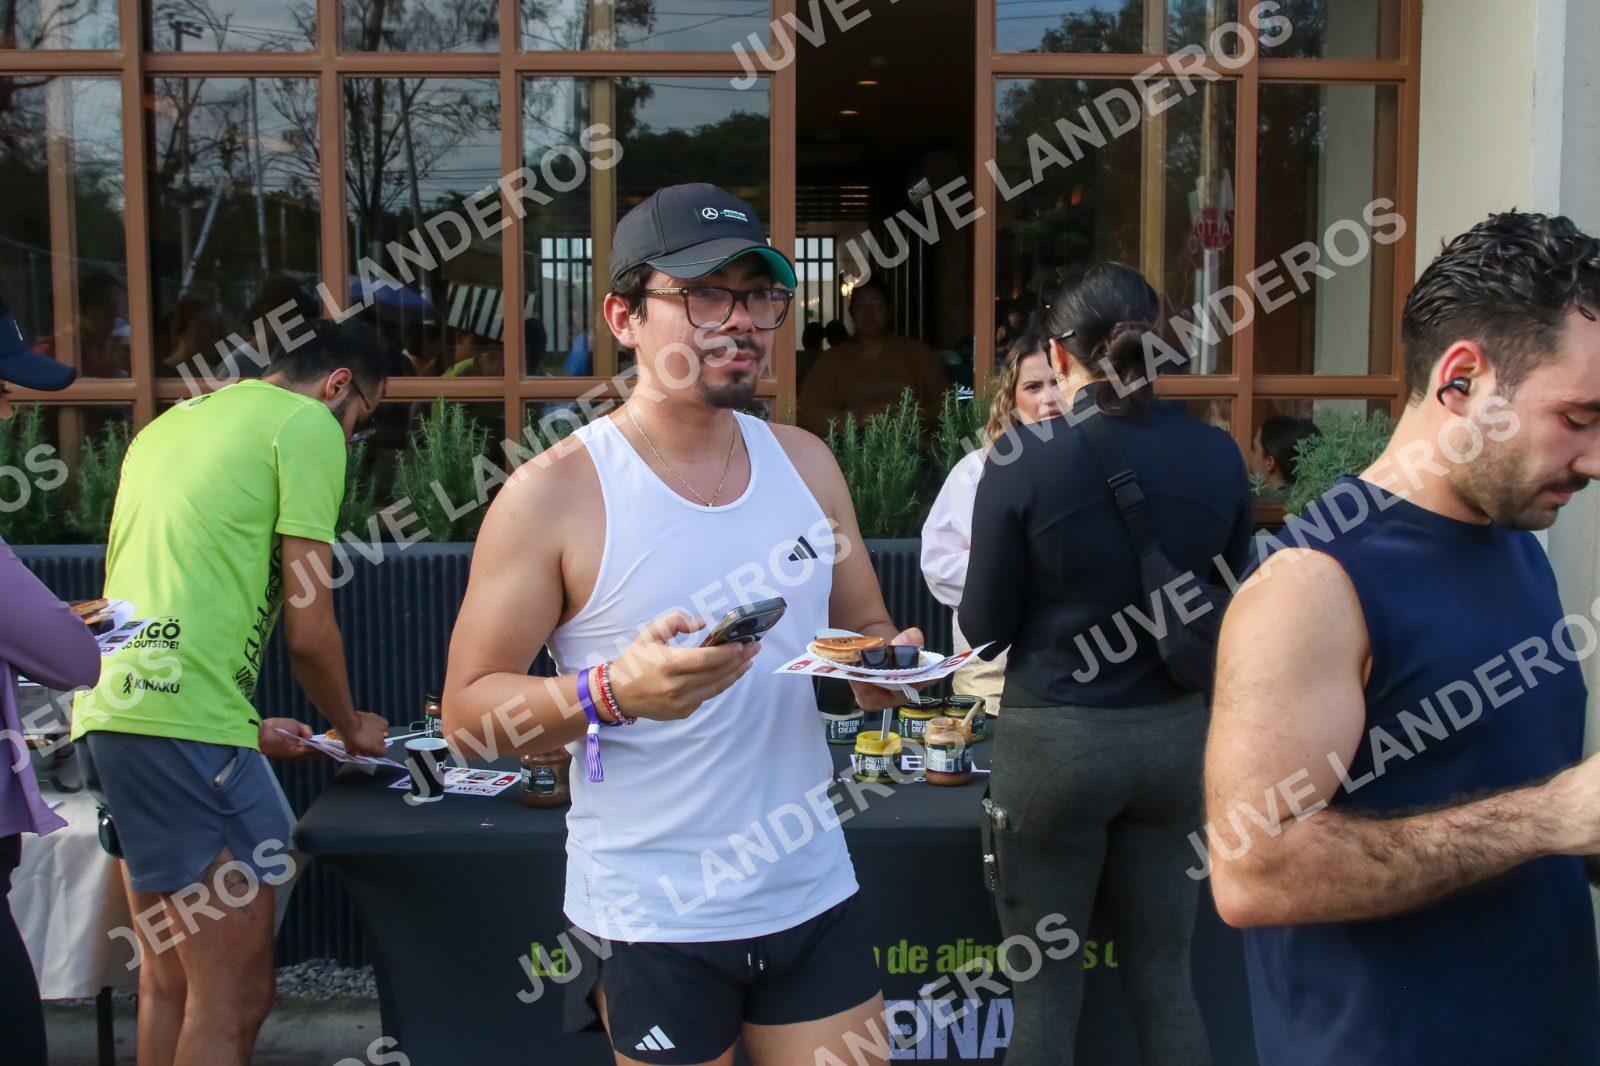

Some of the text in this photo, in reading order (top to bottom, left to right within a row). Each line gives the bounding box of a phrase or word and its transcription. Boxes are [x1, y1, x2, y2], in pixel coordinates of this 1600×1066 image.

[134, 677, 180, 694] KINAKU
[531, 942, 566, 976] La
[887, 939, 928, 974] de
